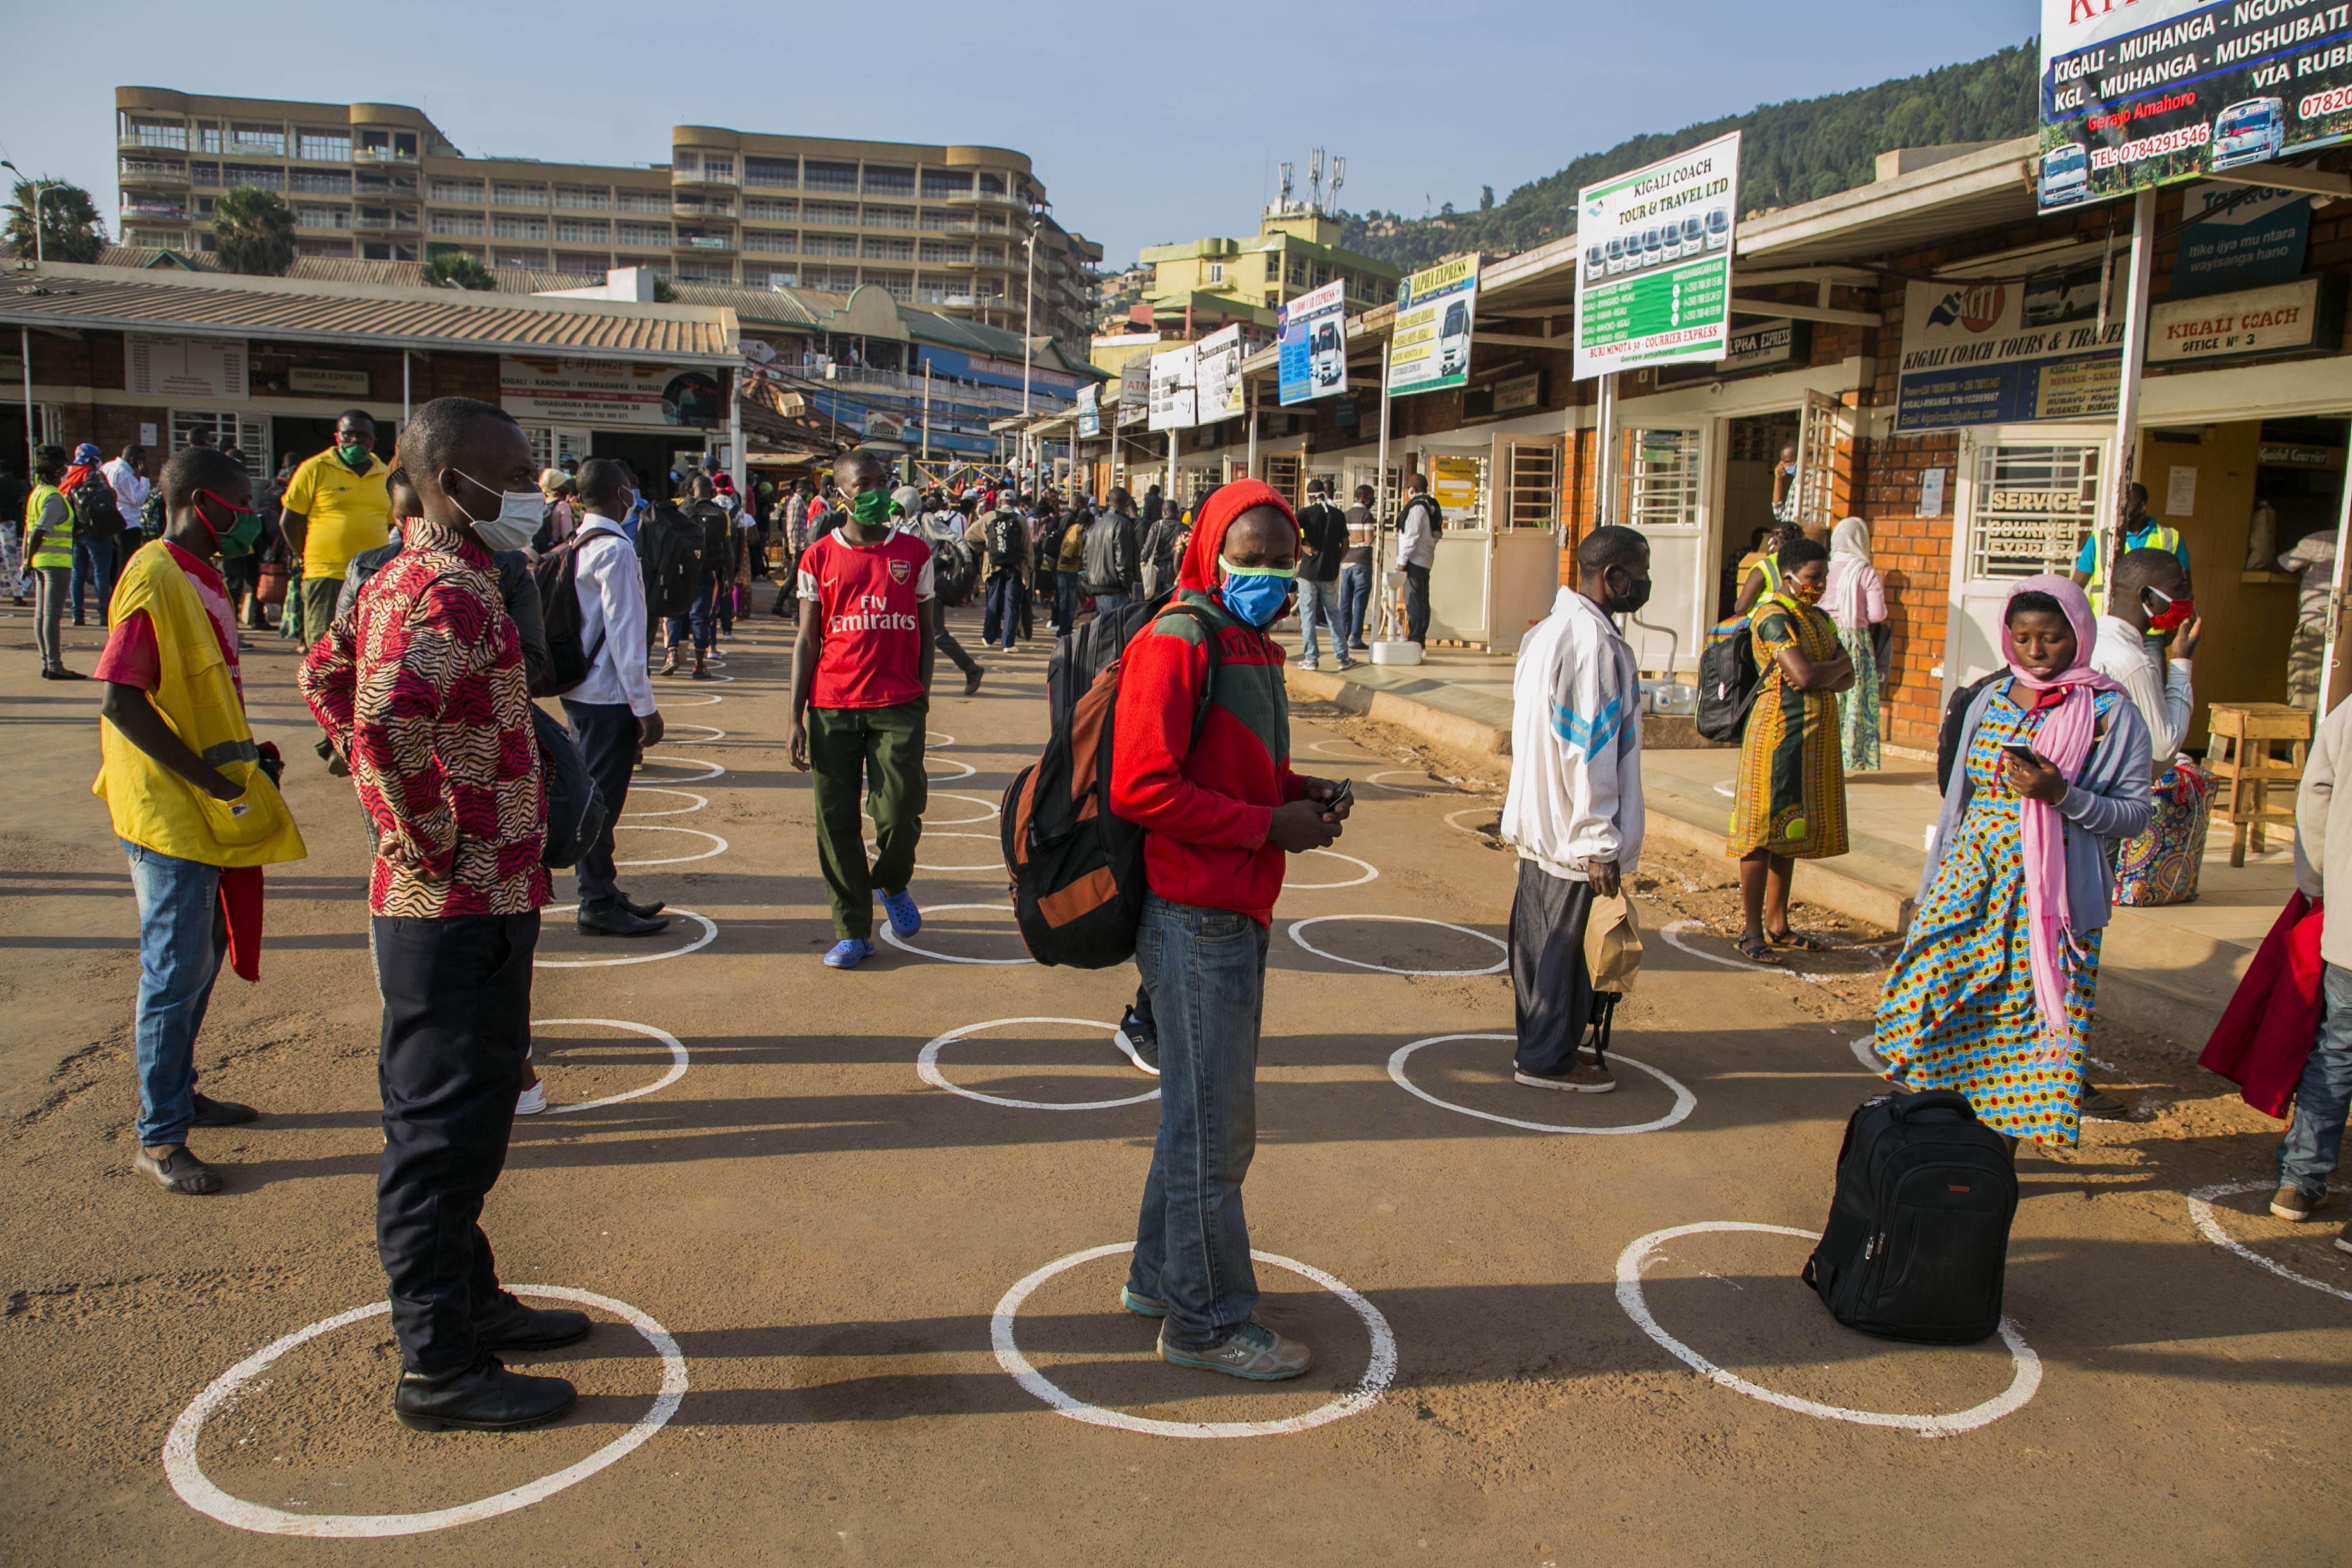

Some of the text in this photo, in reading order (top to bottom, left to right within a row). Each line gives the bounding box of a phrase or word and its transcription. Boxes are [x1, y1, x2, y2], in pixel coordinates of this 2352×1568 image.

[2054, 49, 2106, 84] KIGALI
[2119, 14, 2216, 64] MUHANGA
[2054, 89, 2084, 112] KGL
[2100, 53, 2198, 100] MUHANGA
[2216, 3, 2350, 65] MUSHUBATI
[2252, 62, 2291, 88] VIA
[2087, 91, 2196, 132] Gerayo Amahoro
[2092, 149, 2118, 168] TEL:
[2120, 126, 2208, 162] 0784291546
[1634, 158, 1712, 198] KIGALI COACH
[1618, 177, 1728, 225] TOUR & TRAVEL LTD
[2189, 227, 2296, 257] Itike ijya mu ntara
[2190, 245, 2289, 272] wayisanga hano
[1413, 258, 1467, 293] ALPHA EXPRESS
[1307, 297, 1315, 309] CAR
[1315, 289, 1335, 307] EXPRESS
[2167, 307, 2300, 340] KIGALI COACH
[1590, 325, 1717, 358] BURI MINOTA 30 COURRIER EXPRESS
[1760, 328, 1790, 348] EXPRESS
[1902, 346, 1949, 370] KIGALI
[1950, 340, 1996, 364] COACH
[2000, 334, 2044, 358] TOURS
[2047, 330, 2062, 351] &
[2182, 338, 2218, 352] OFFICE
[2246, 334, 2255, 345] 3
[1621, 348, 1675, 363] Gerayo amahoro!
[295, 371, 365, 382] OMEGA EXPRESS
[2049, 364, 2079, 374] KIGALI
[501, 378, 527, 386] KIGALI
[535, 379, 570, 387] KARONGI
[578, 381, 629, 390] NYAMASHEKE
[1127, 380, 1150, 391] ATM
[2046, 402, 2118, 415] MUSANZE RUBAVU
[2047, 395, 2086, 406] RUBAVU
[872, 426, 897, 436] EQUITY
[1993, 492, 2081, 511] SERVICE
[861, 595, 887, 611] Fly
[830, 609, 916, 634] Emirates
